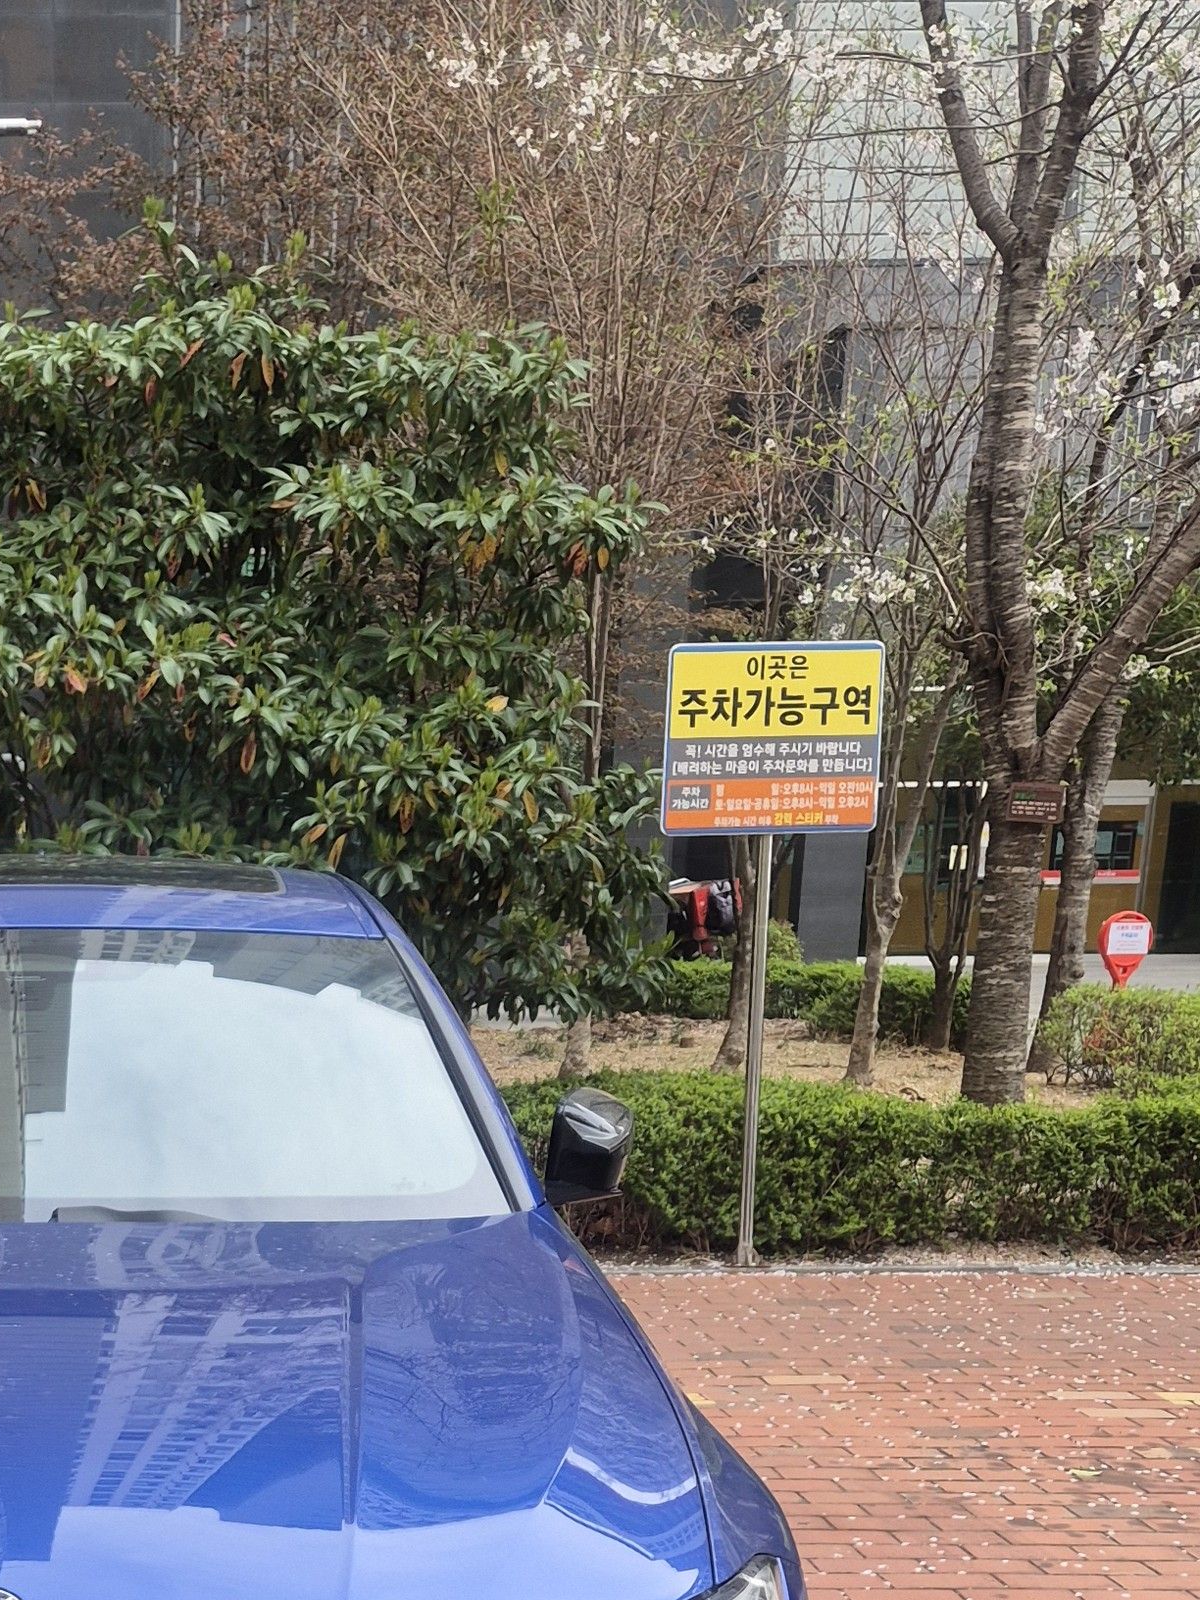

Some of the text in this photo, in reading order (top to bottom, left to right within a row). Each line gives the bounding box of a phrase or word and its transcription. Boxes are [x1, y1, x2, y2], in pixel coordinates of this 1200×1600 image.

[747, 655, 809, 680] 이곳은
[678, 684, 872, 728] 주차가능구역
[685, 744, 701, 759] 꼭!
[705, 743, 739, 758] 시간을
[779, 742, 813, 757] 주시기
[816, 741, 862, 756] 바랍니다
[672, 757, 872, 776] [배려하는 마음이 주차문화를 만듭니다]
[681, 786, 700, 797] 주차
[672, 798, 709, 809] 가능시간
[795, 811, 823, 825] 스티커
